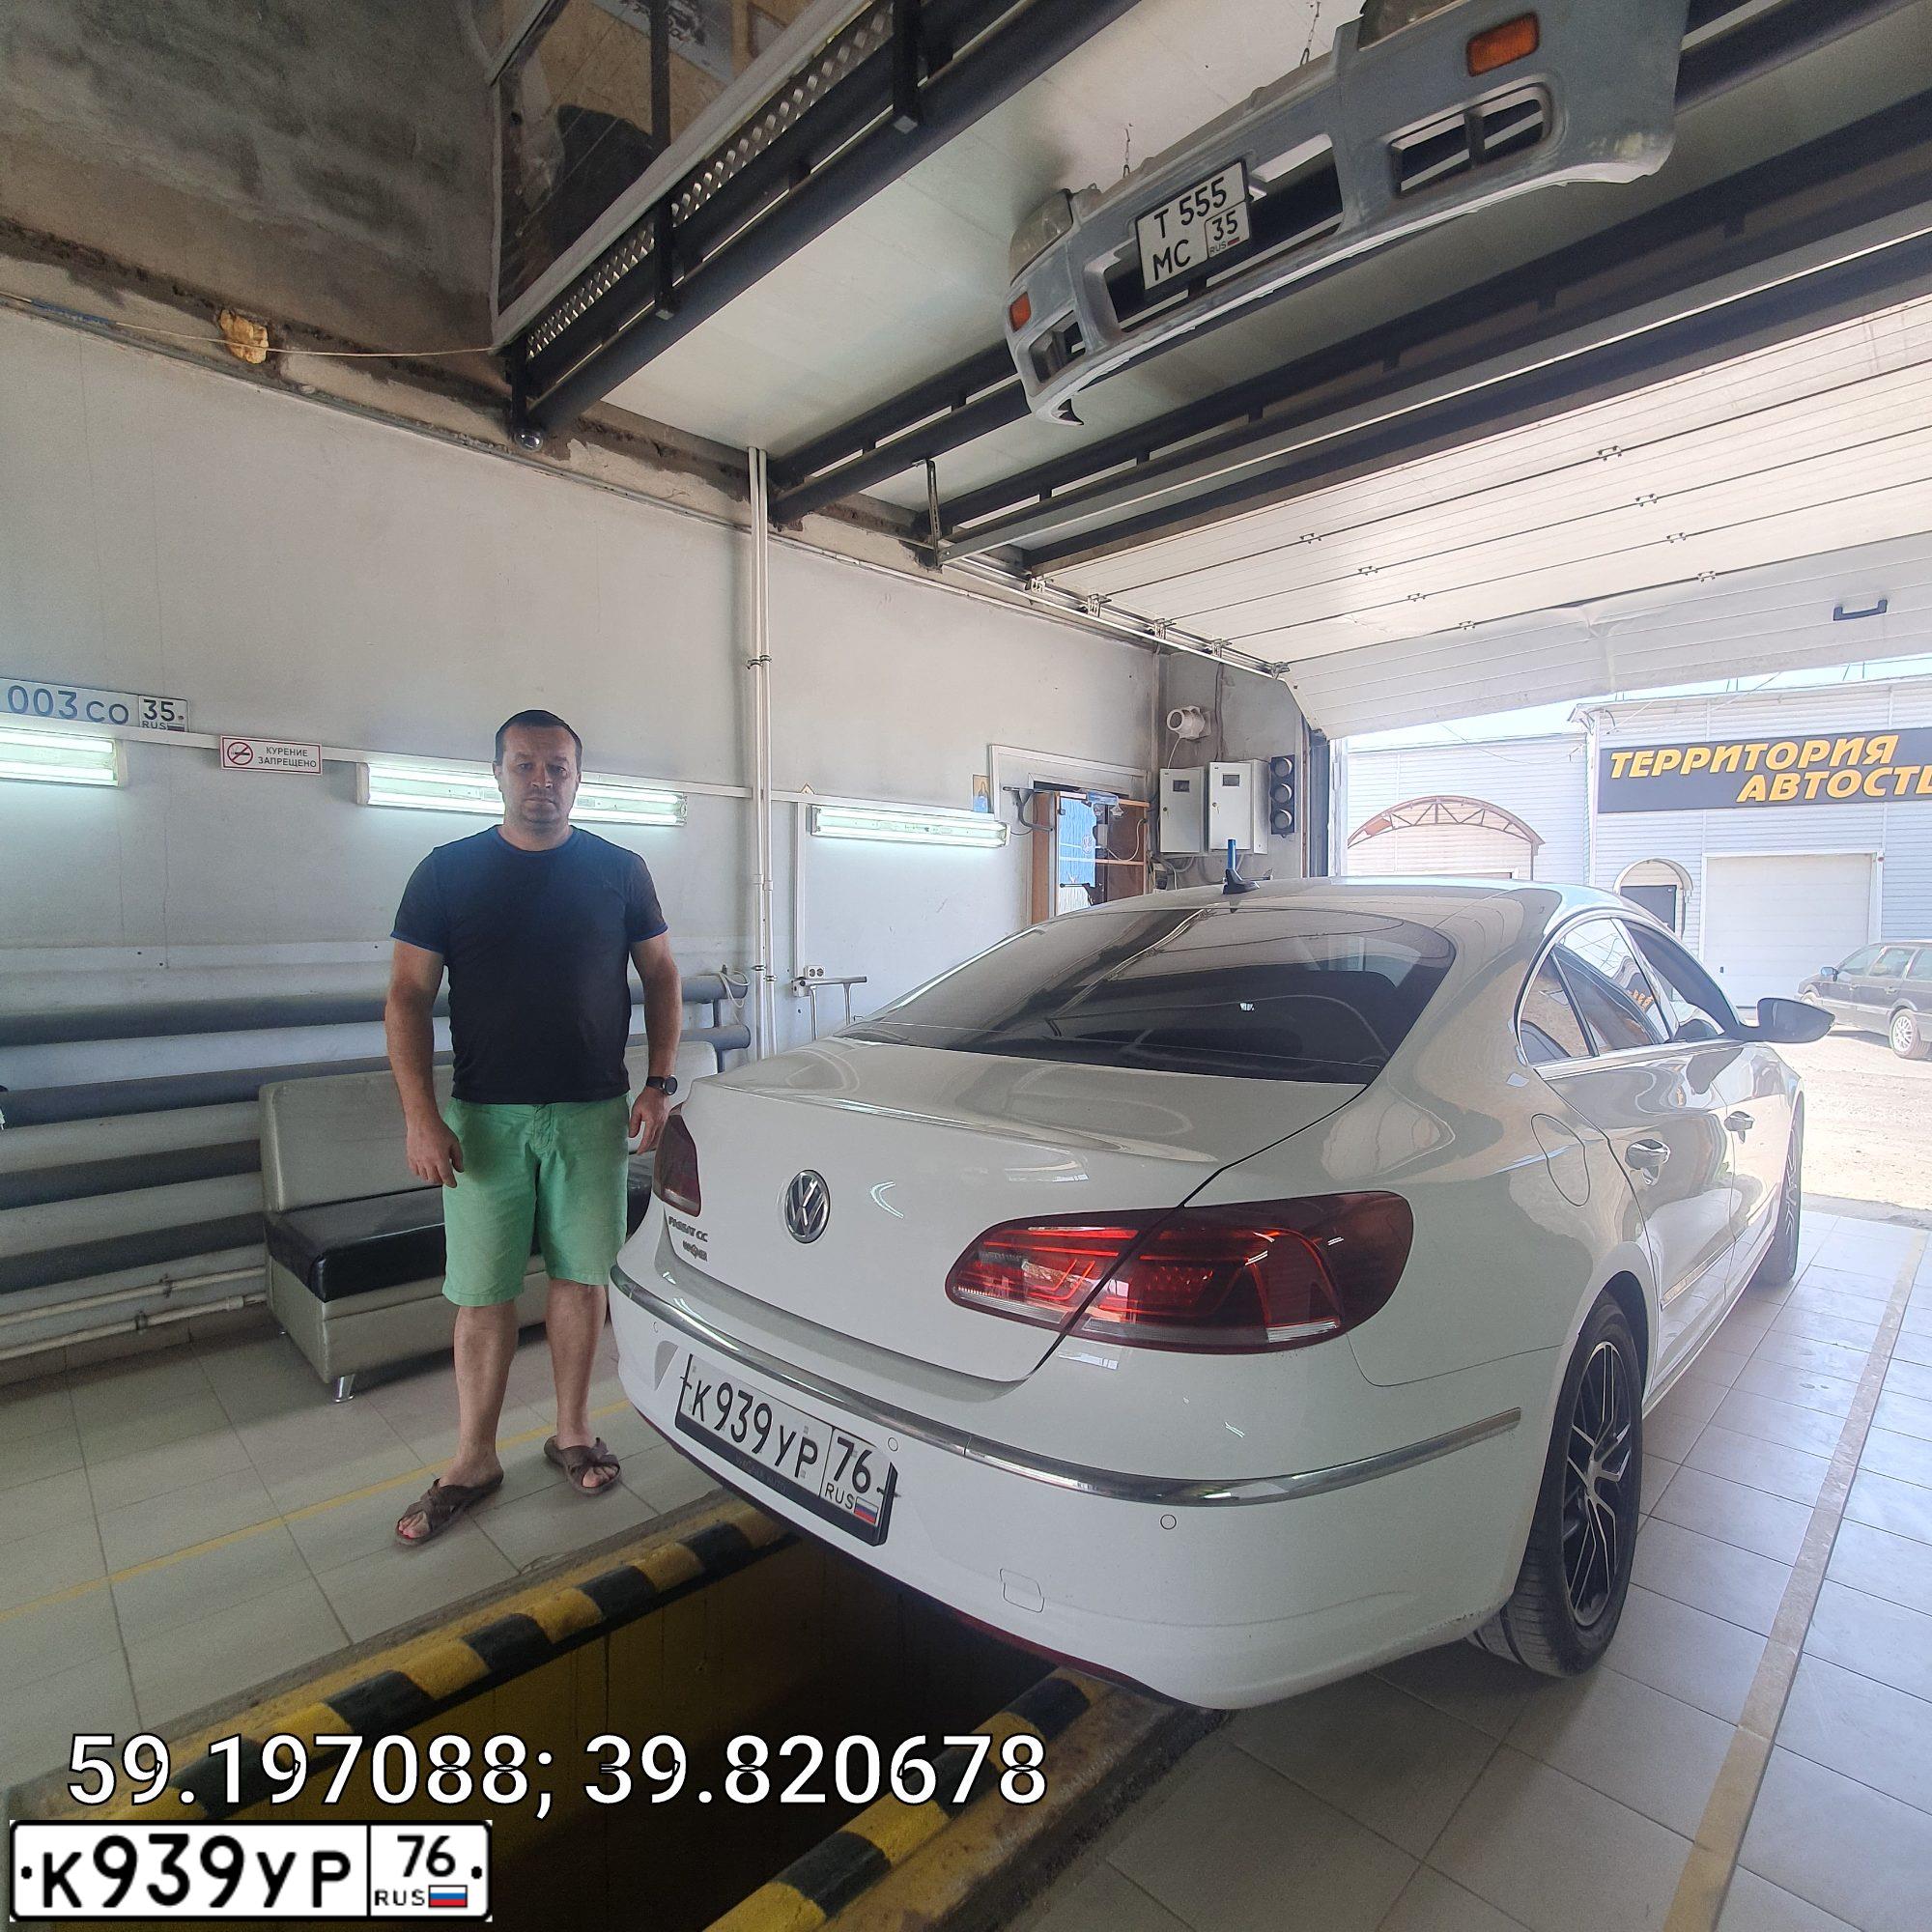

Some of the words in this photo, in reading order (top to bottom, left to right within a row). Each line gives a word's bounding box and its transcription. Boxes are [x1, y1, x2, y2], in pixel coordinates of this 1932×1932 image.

[1179, 176, 1227, 226] 555
[1211, 209, 1238, 242] 35
[1152, 239, 1191, 282] МС
[1208, 241, 1228, 255] RUS
[143, 698, 176, 723] 35
[141, 719, 168, 731] RUS
[257, 755, 317, 768] ЗАПРЕЩЕНО
[266, 746, 308, 757] КУРЕНИЕ
[1609, 734, 1899, 779] ТЕРРИТОРИЯ
[834, 1435, 873, 1493] 76
[824, 1482, 854, 1510] RUS
